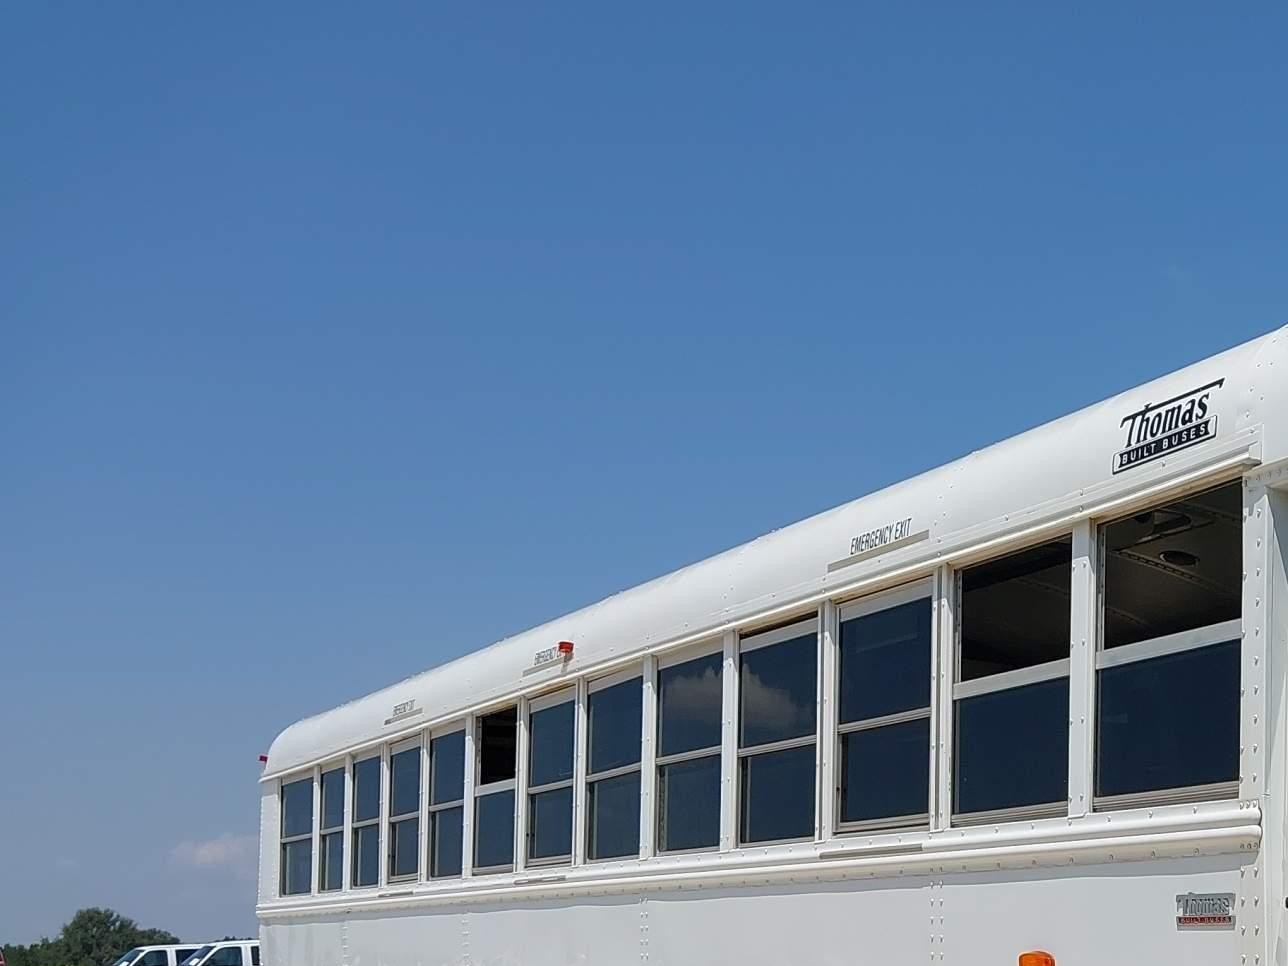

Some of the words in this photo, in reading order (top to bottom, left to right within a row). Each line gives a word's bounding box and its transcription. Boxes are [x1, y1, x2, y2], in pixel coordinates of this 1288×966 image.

[1120, 378, 1225, 448] Thomas
[1122, 443, 1157, 465] BUILT
[1162, 423, 1206, 449] BUSES
[849, 523, 894, 555] EMERGENCY
[895, 518, 912, 540] EXIT
